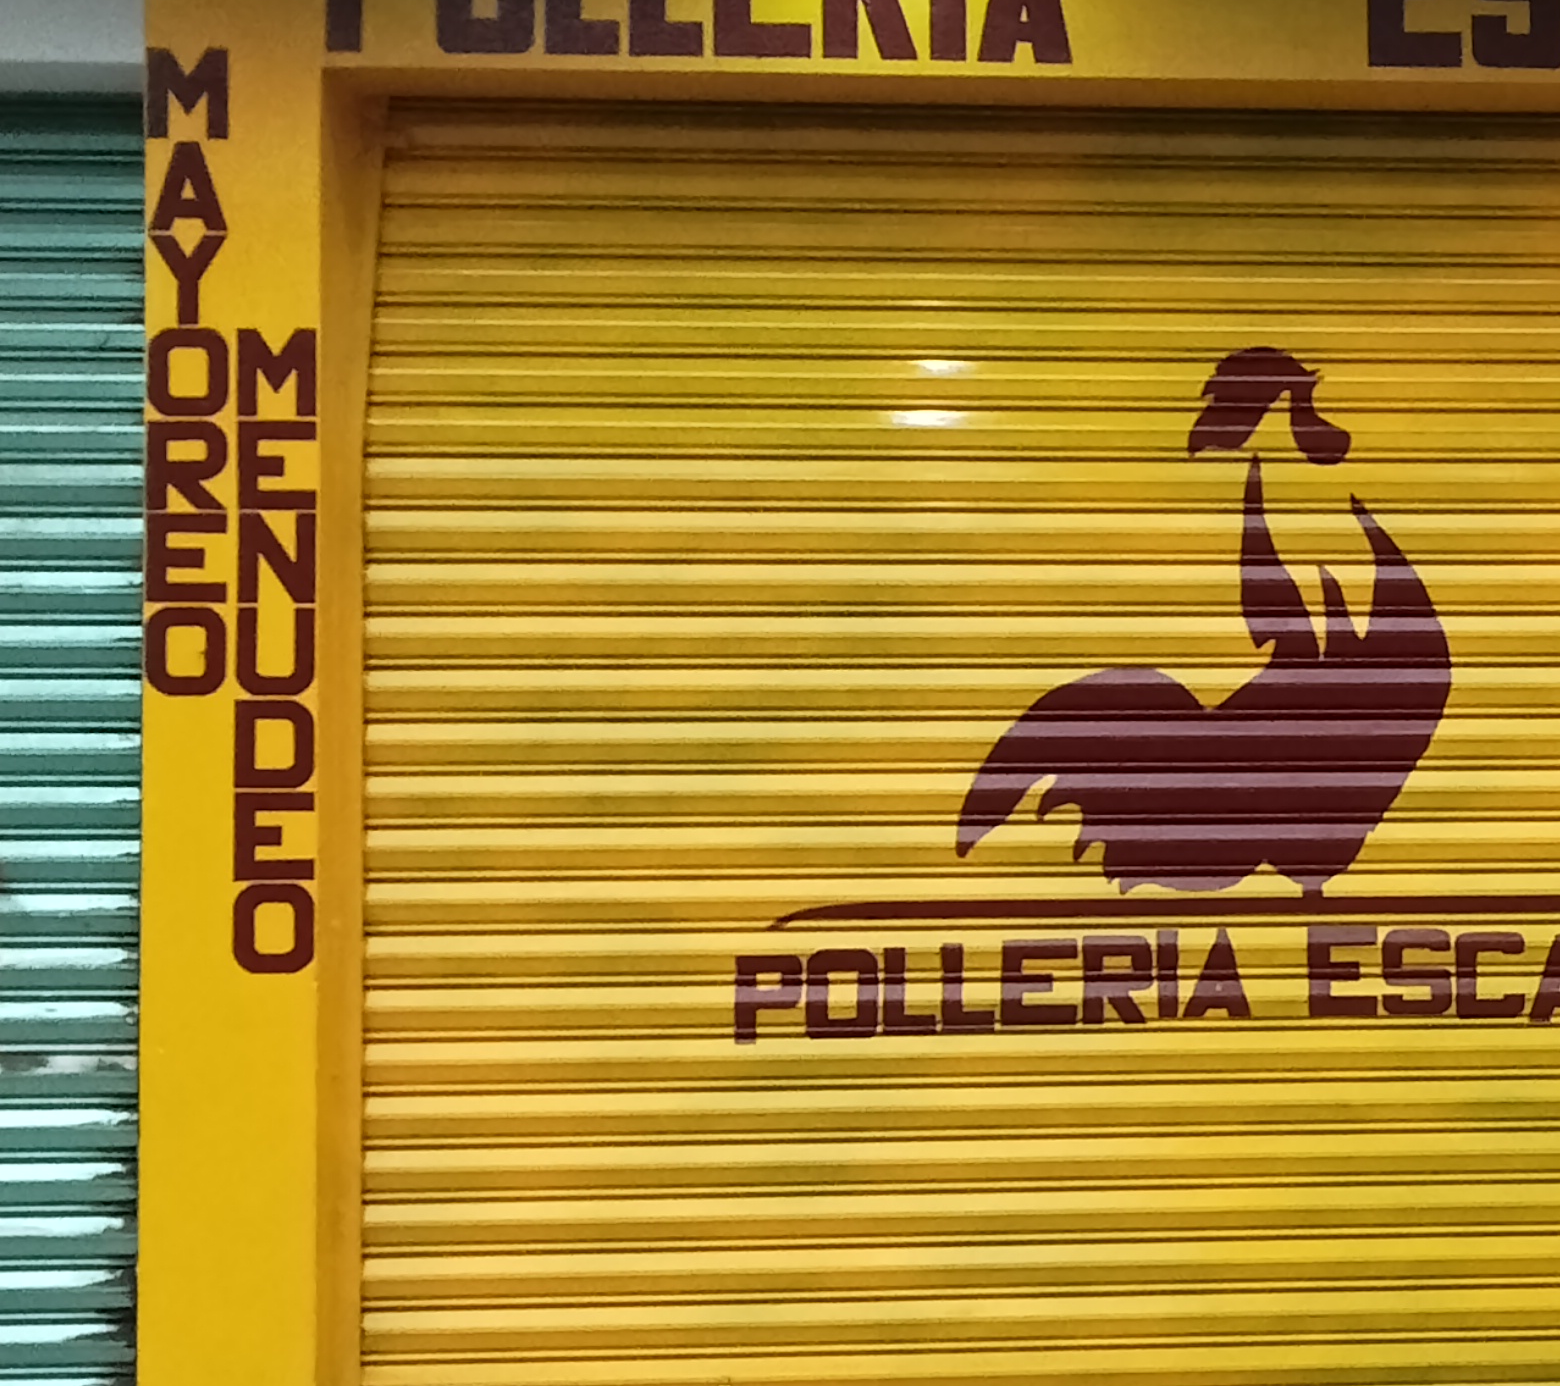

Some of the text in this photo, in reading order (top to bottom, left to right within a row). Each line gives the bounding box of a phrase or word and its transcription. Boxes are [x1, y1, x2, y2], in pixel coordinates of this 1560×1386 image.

[145, 47, 229, 696] MAYOREO
[233, 328, 317, 973] MENUDEO
[734, 929, 1251, 1044] POLLERIA
